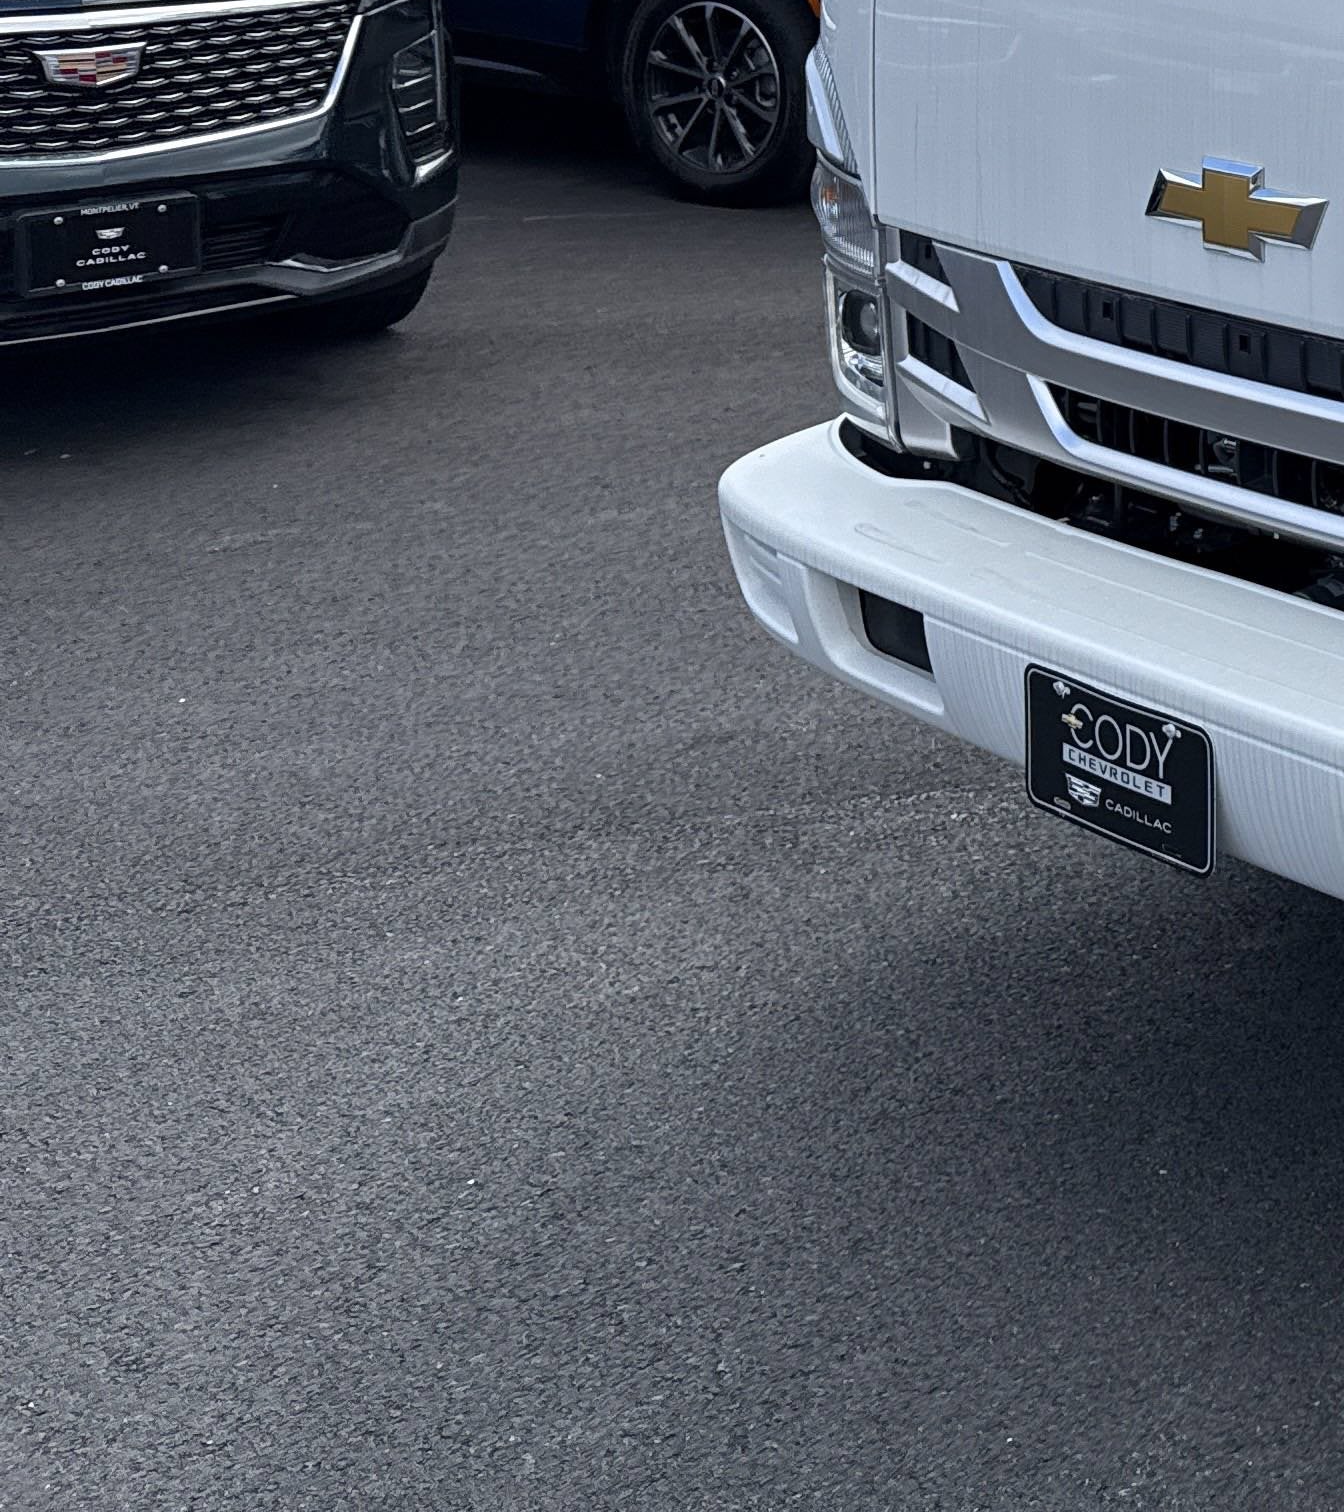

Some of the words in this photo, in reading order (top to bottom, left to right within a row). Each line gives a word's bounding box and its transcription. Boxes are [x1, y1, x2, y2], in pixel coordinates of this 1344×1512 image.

[76, 252, 146, 266] CADILLAC
[92, 245, 130, 255] CODY
[82, 279, 105, 290] CODY
[105, 275, 143, 287] CADILLAC
[1068, 703, 1174, 779] CODY
[1068, 747, 1166, 799] CHEVROLET
[1104, 799, 1173, 834] CADILLAC
